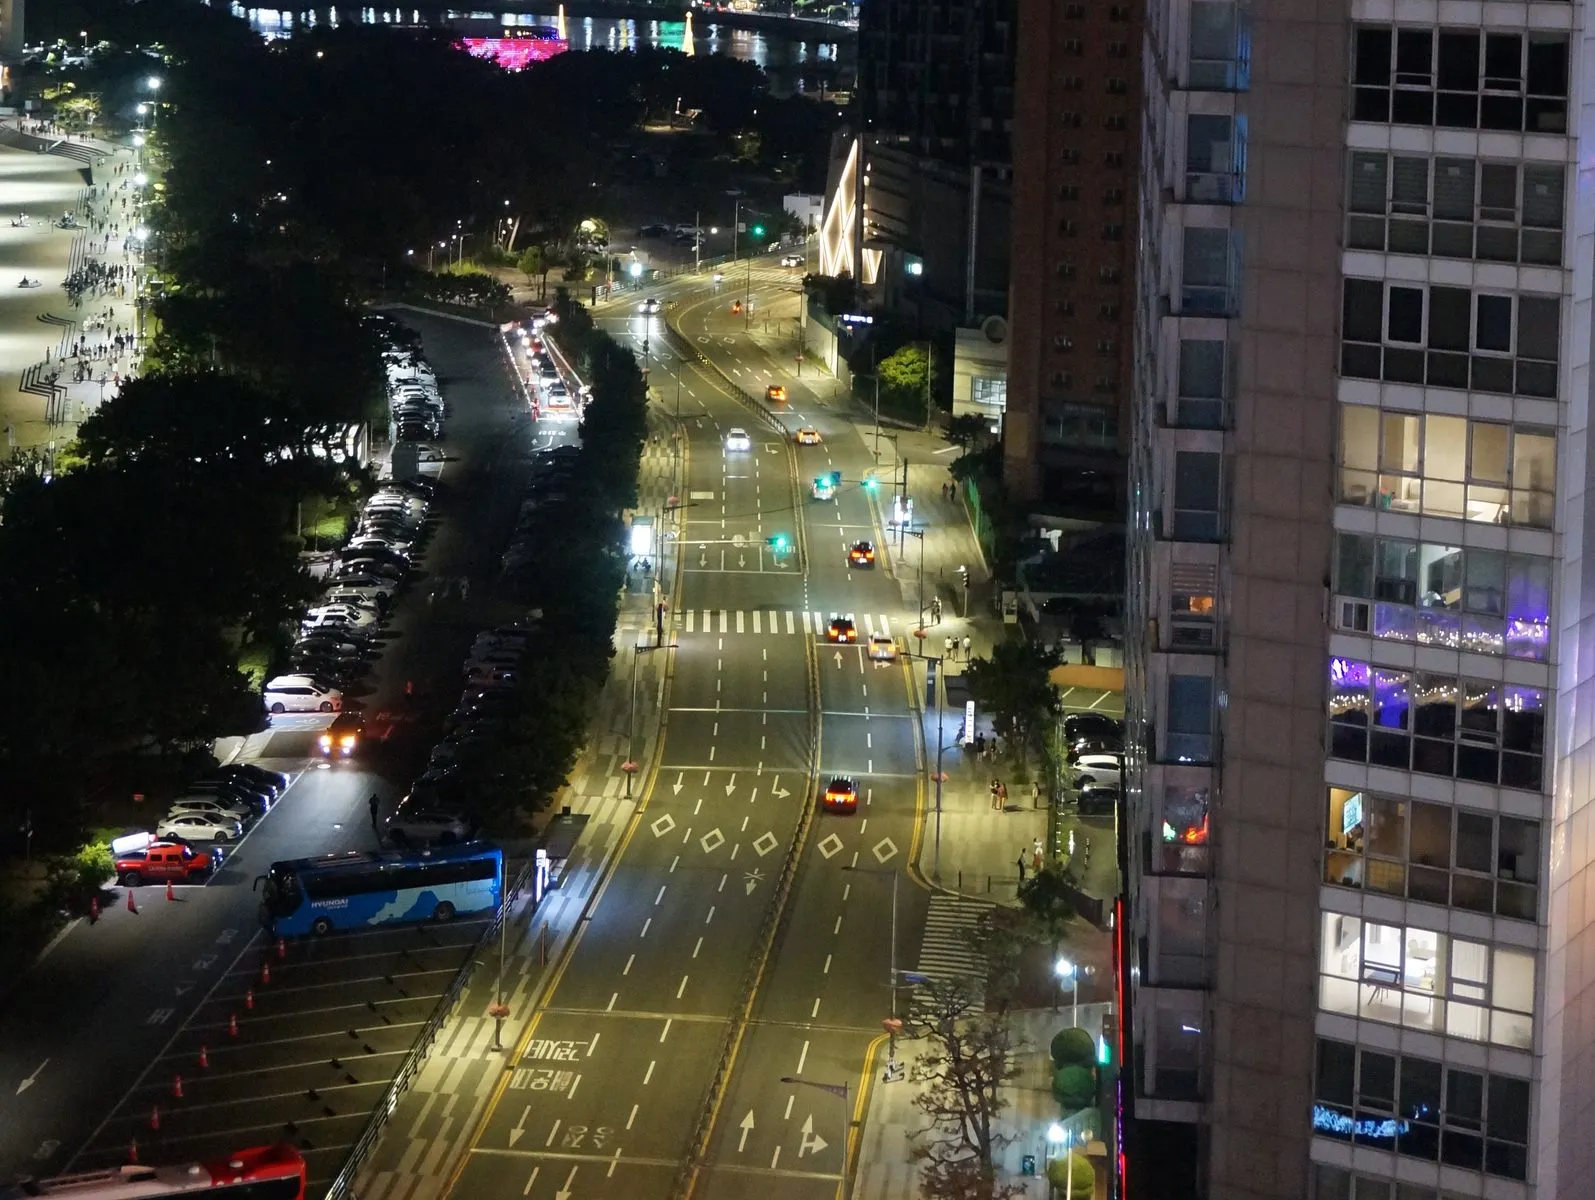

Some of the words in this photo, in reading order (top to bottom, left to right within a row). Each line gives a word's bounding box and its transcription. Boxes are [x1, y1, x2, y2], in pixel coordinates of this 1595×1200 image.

[311, 898, 349, 909] HYUNDAI
[522, 1039, 589, 1062] 그린시티
[509, 1068, 574, 1092] 해운대
[561, 1125, 615, 1149] 송정
